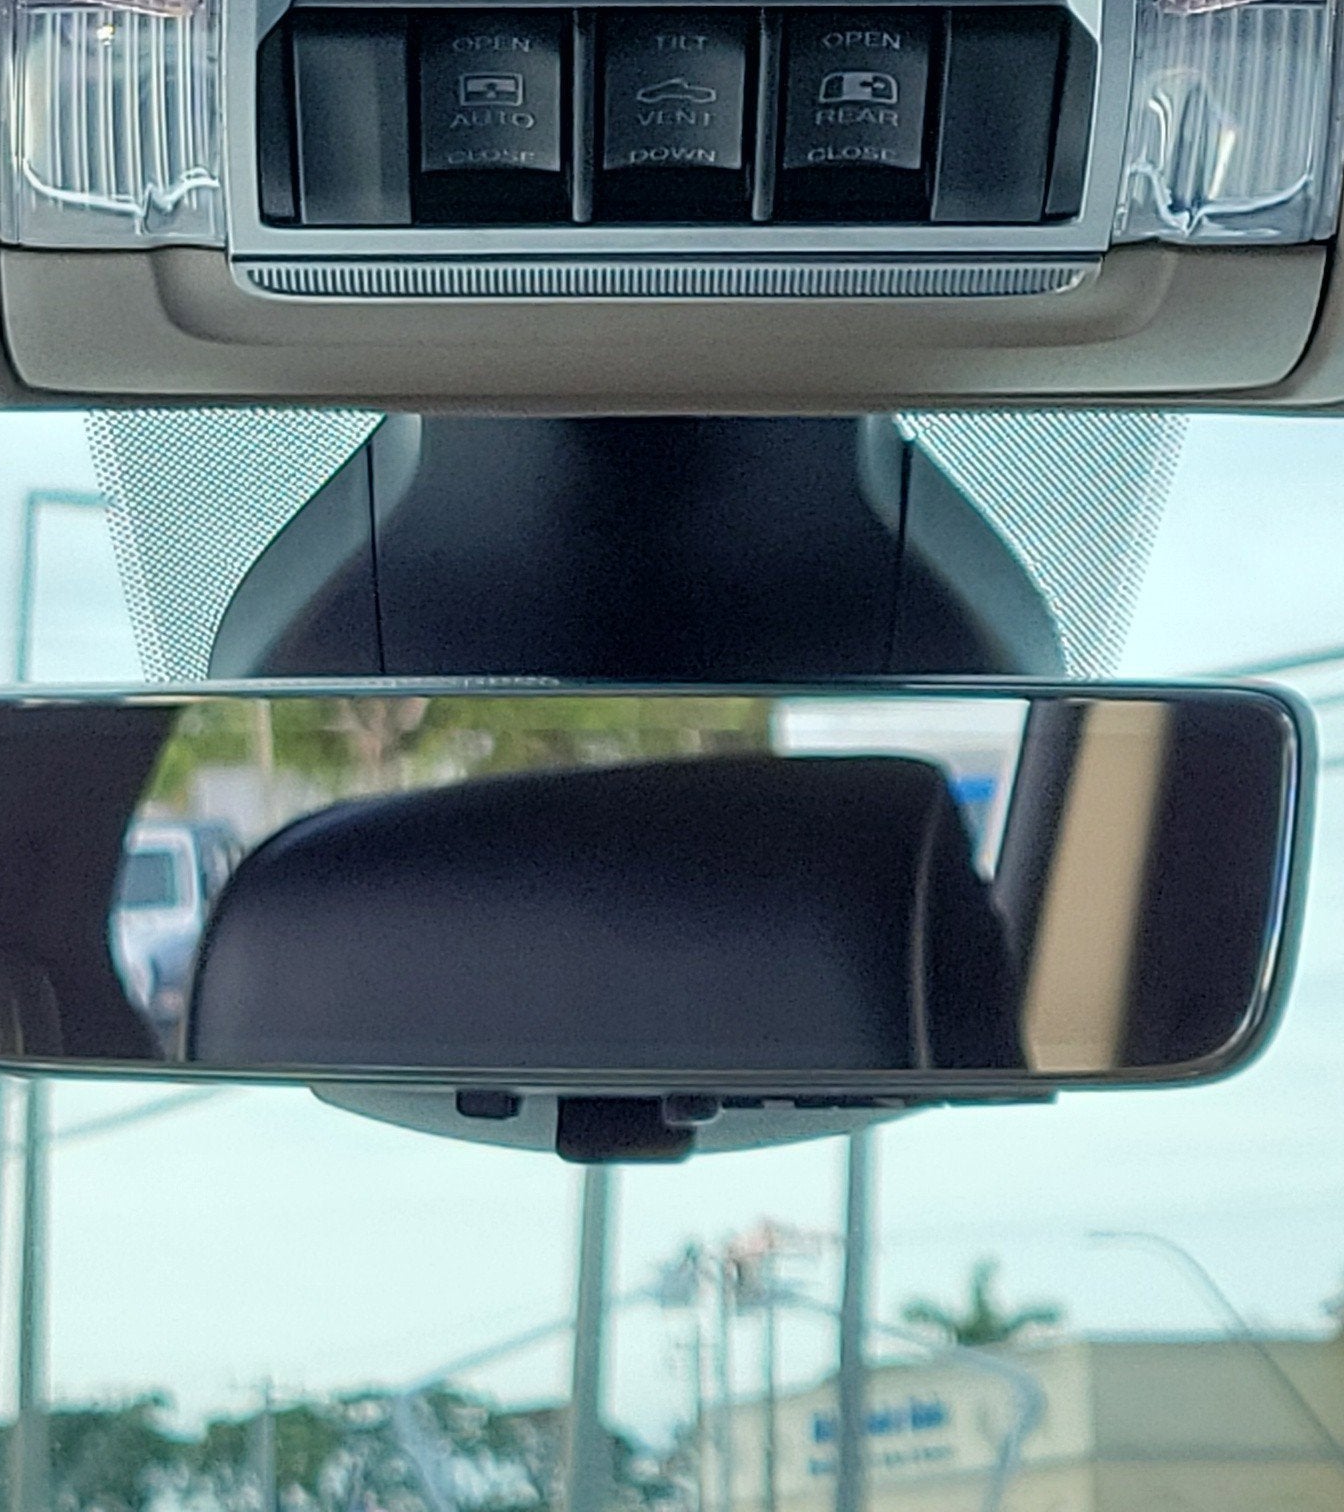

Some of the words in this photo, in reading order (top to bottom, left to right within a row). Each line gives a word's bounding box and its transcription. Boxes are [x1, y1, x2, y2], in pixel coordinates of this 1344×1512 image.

[452, 35, 531, 53] OPEN
[656, 34, 708, 50] TILT
[822, 30, 901, 49] OPEN
[449, 110, 535, 128] AUTO
[637, 110, 716, 127] VENT
[815, 108, 899, 127] REAR
[447, 149, 536, 164] CLOSE
[629, 148, 716, 164] DOWN
[806, 146, 898, 162] CLOSE
